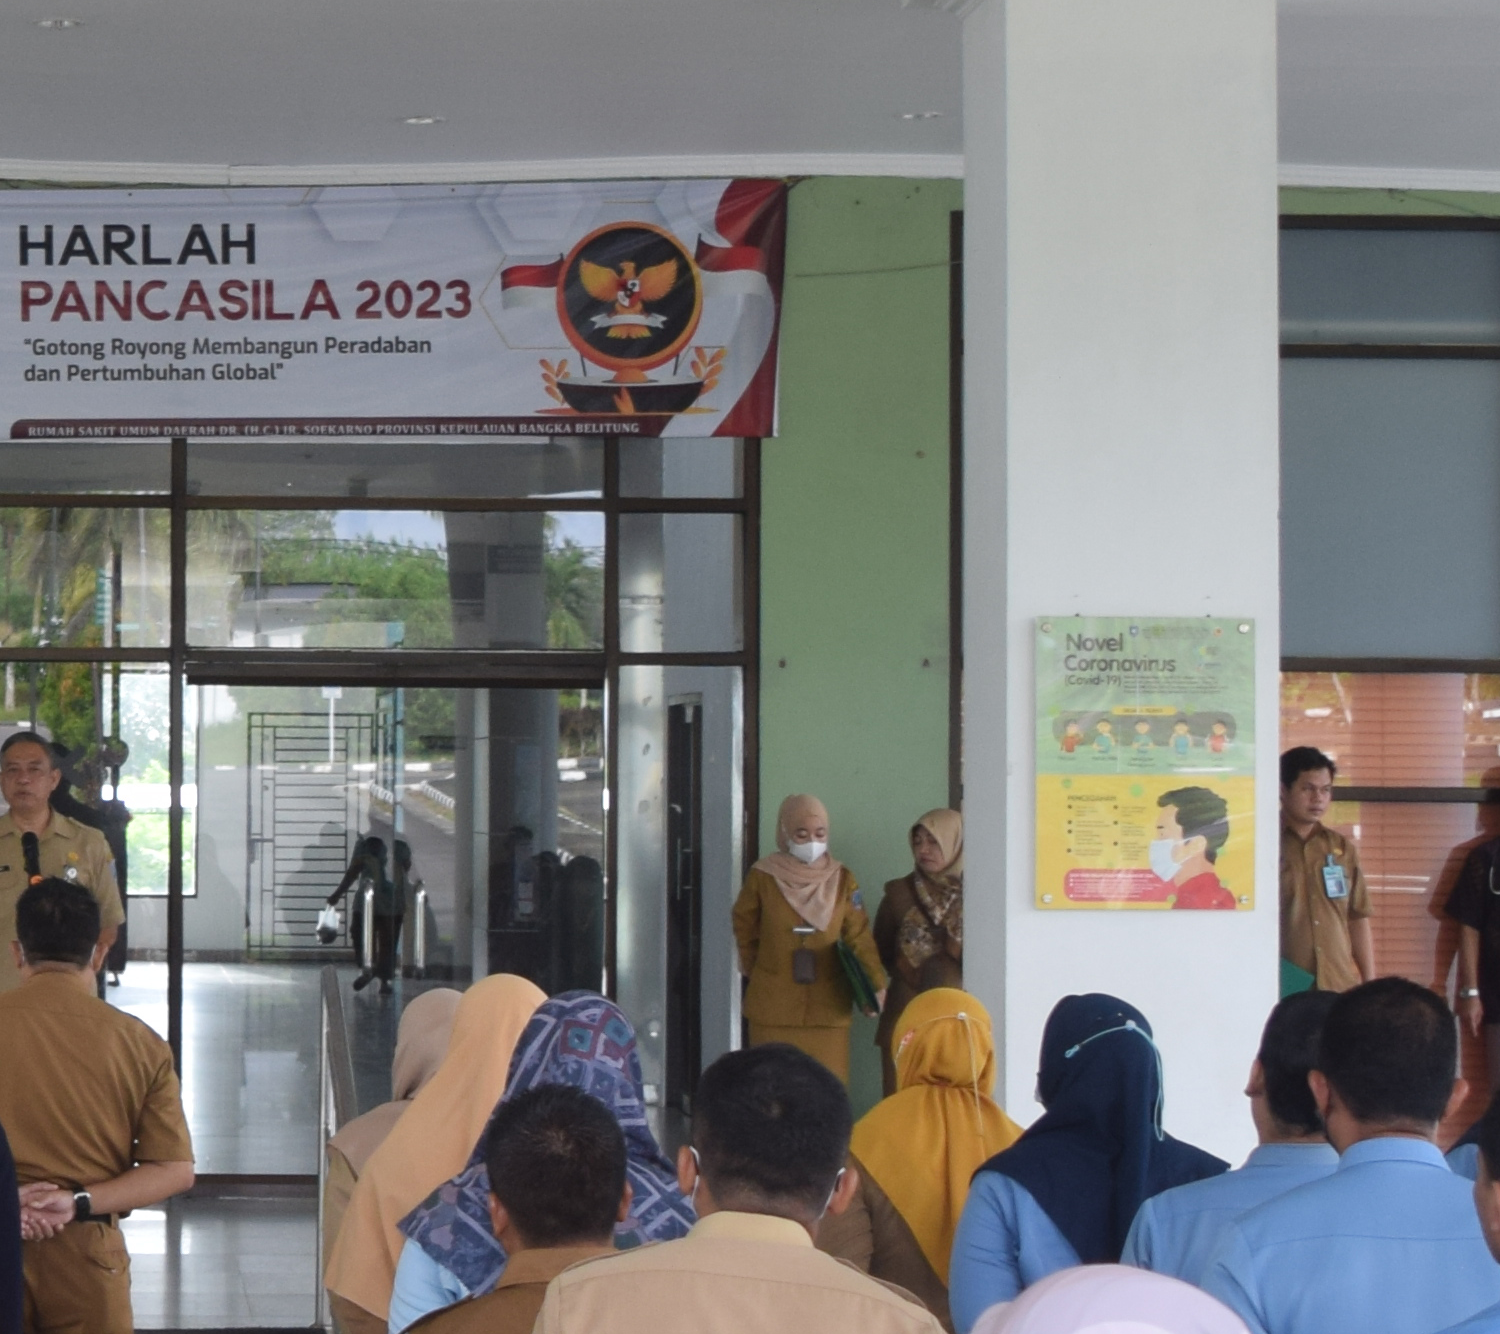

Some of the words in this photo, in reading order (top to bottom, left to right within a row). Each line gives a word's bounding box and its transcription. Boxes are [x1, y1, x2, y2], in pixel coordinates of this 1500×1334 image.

[18, 223, 256, 266] HARLAH
[19, 279, 340, 322] PANCASILA
[355, 279, 472, 319] 2023
[111, 338, 186, 359] Royong
[193, 337, 318, 358] Membangun
[325, 336, 431, 354] Peradaban
[24, 364, 60, 382] dan
[67, 363, 206, 382] Pertumbuhan
[28, 426, 74, 437] RUMAH
[78, 426, 116, 437] SAKIT
[120, 426, 160, 436] UMUM
[164, 425, 215, 436] DAERAH
[303, 424, 372, 435] SOEKARNO
[376, 424, 436, 434] PROVINSI
[440, 424, 514, 434] KEPULAUAN
[519, 423, 571, 433] BANGKA
[575, 423, 640, 433] BELITUNG
[1065, 633, 1123, 652] Novel
[1064, 654, 1176, 672] Coronavirus
